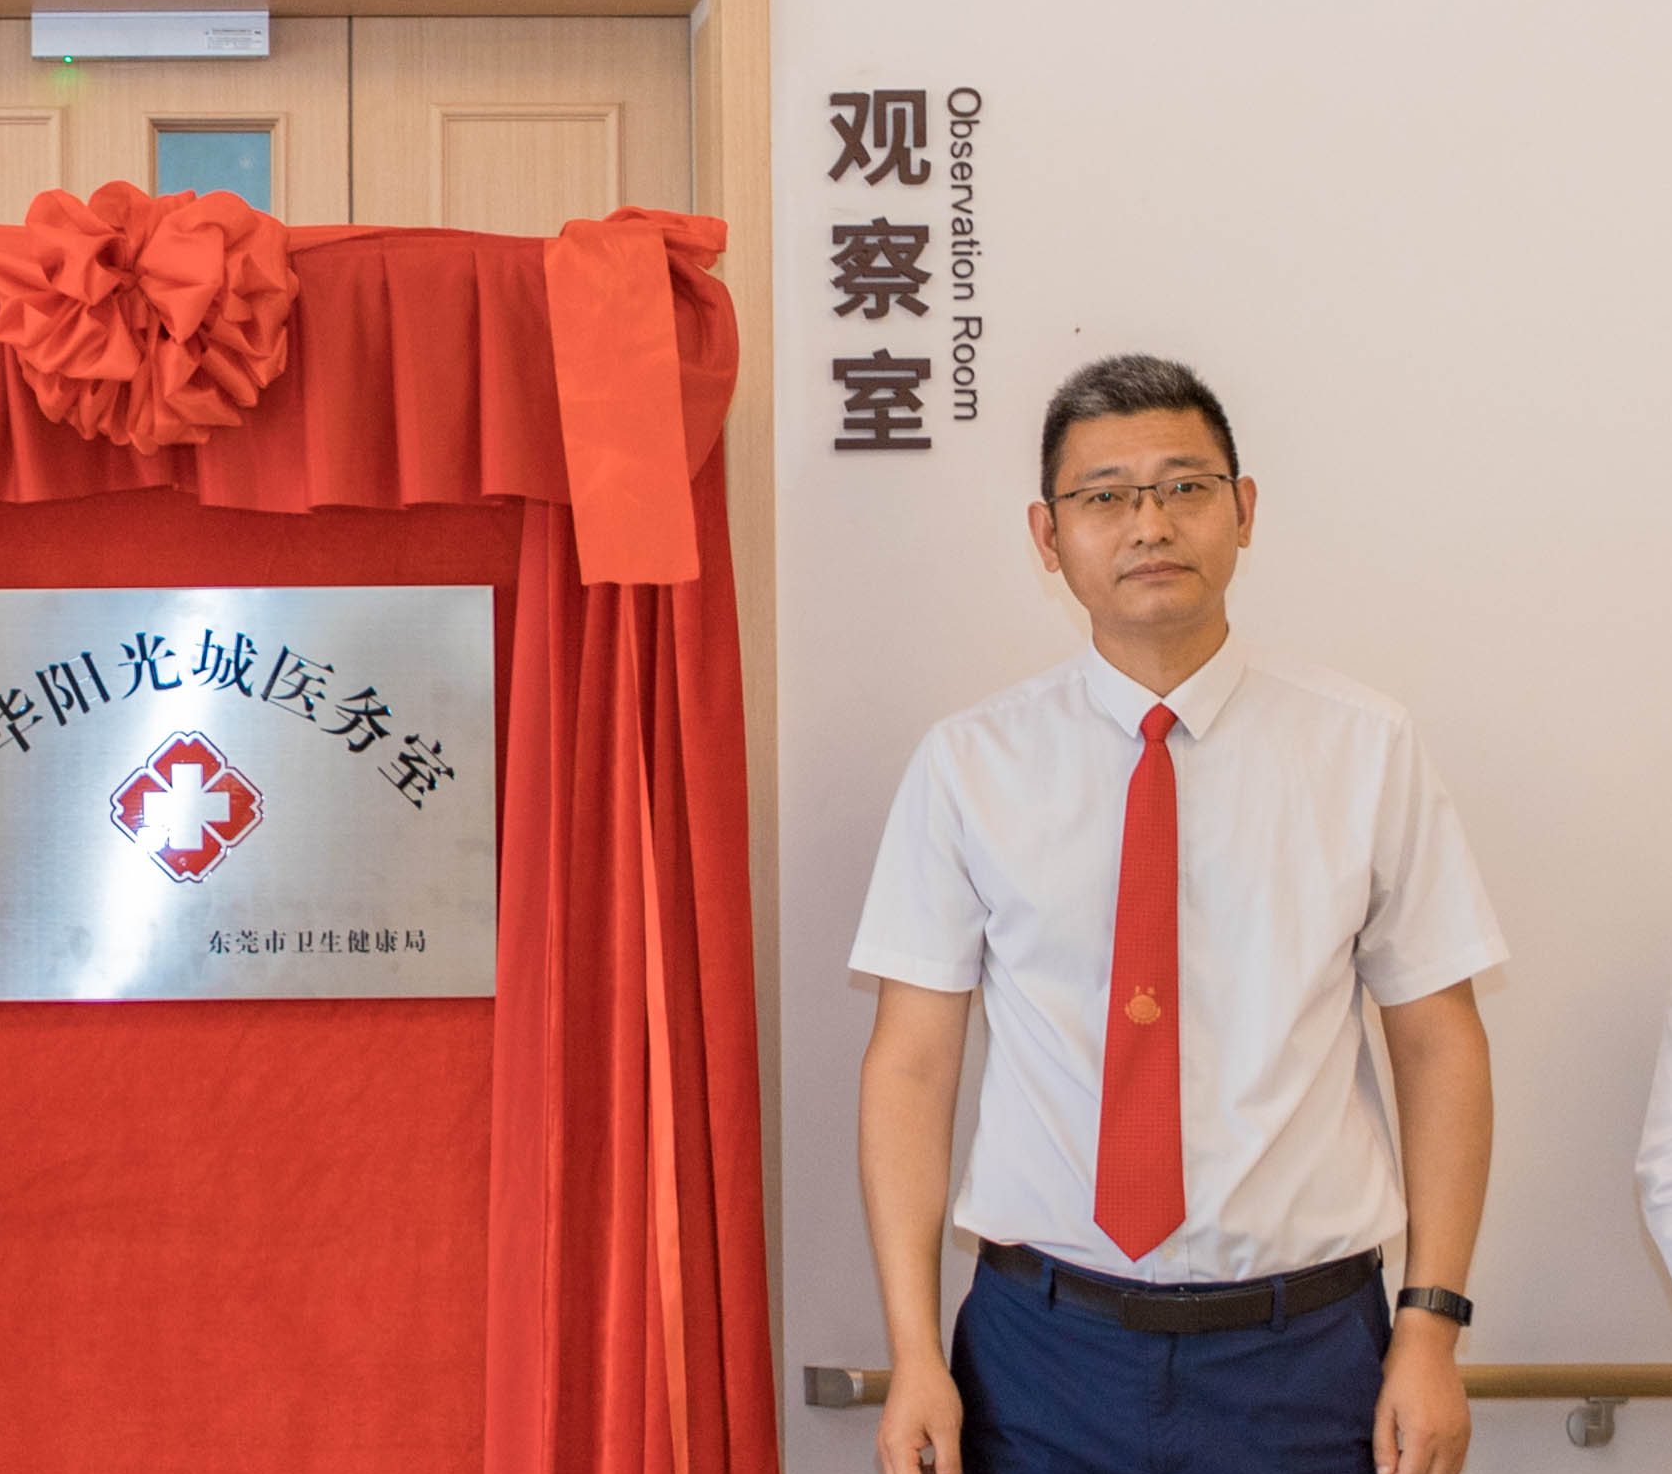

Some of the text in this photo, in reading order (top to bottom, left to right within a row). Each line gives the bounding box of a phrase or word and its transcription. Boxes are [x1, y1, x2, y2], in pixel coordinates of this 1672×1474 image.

[828, 89, 932, 450] 观察室
[947, 87, 983, 421] Observation Room
[209, 929, 427, 954] 东莞市卫生健康局
